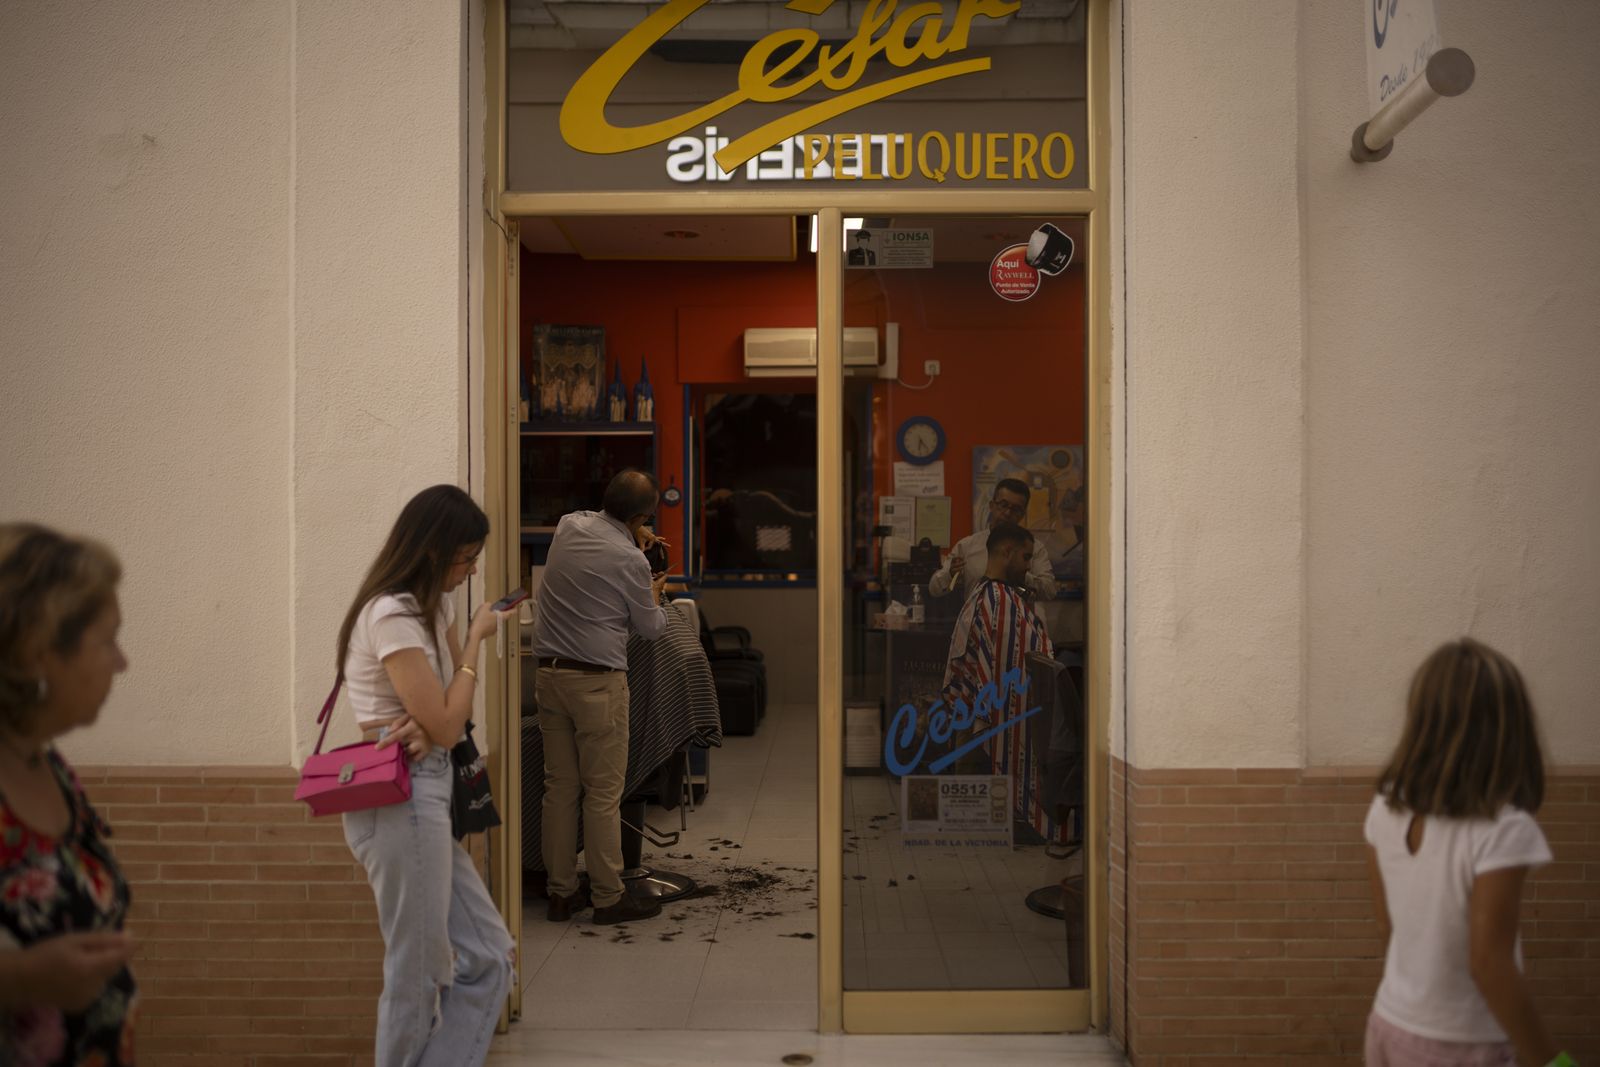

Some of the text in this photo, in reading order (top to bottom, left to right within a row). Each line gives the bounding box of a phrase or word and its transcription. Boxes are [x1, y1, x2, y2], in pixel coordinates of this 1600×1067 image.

[803, 131, 1075, 183] PELUQUERO
[892, 232, 930, 241] IONSA
[941, 784, 988, 795] 05512
